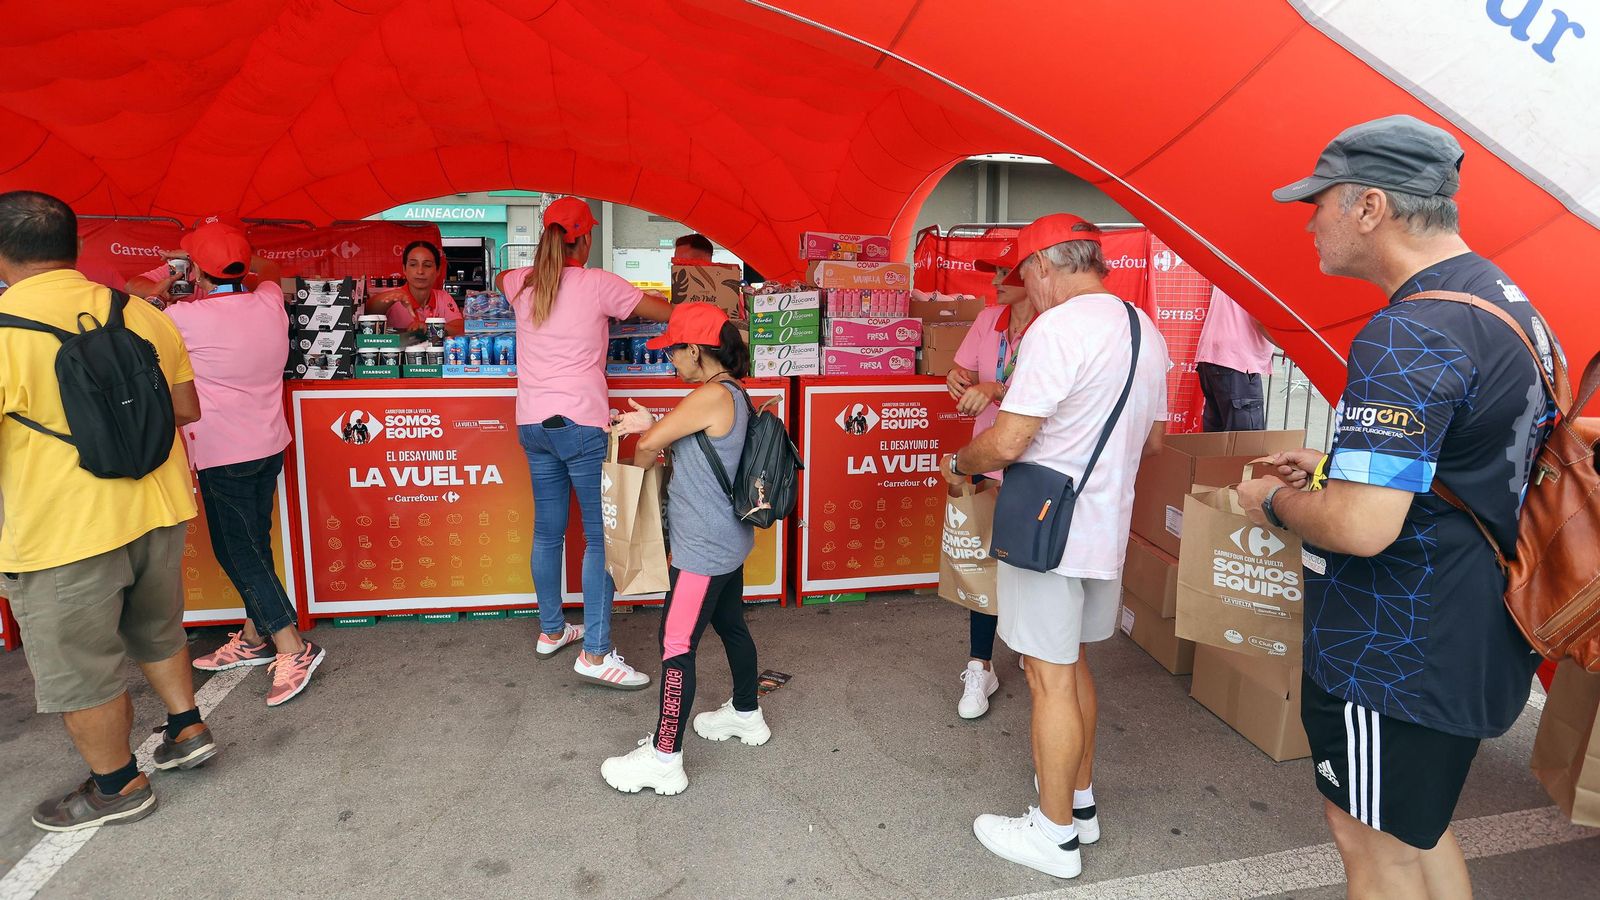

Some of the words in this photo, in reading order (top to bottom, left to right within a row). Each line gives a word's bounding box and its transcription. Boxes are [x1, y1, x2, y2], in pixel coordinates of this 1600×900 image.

[404, 207, 486, 219] ALINEACION
[110, 241, 165, 257] Carref
[856, 261, 880, 269] COVAP
[866, 332, 889, 341] FRESA
[859, 361, 882, 370] FRESA
[881, 407, 928, 419] SOMOS
[384, 414, 441, 427] SOMOS
[880, 419, 929, 430] EQUIPO
[385, 427, 444, 439] EQUIPO
[1362, 427, 1404, 439] FURGONETAS
[880, 441, 889, 451] EL
[890, 440, 928, 450] DESAYUNO
[929, 439, 939, 449] DE
[386, 451, 397, 462] EL
[399, 450, 444, 462] DESAYUNO
[446, 450, 457, 461] DE
[847, 455, 878, 475] LA
[881, 453, 944, 474] VUEL
[349, 467, 386, 488] LA
[389, 464, 504, 487] VUELTA
[883, 479, 920, 488] Carrefour
[394, 493, 438, 503] Carrefour
[1213, 549, 1244, 561] CARREFOUR
[1244, 555, 1255, 563] CON
[1264, 559, 1284, 568] VUELTA
[1212, 557, 1299, 586] SOMOS
[1213, 572, 1302, 602] EQUIPO
[1231, 598, 1252, 608] VUELTA
[663, 667, 683, 717] COLLEGE
